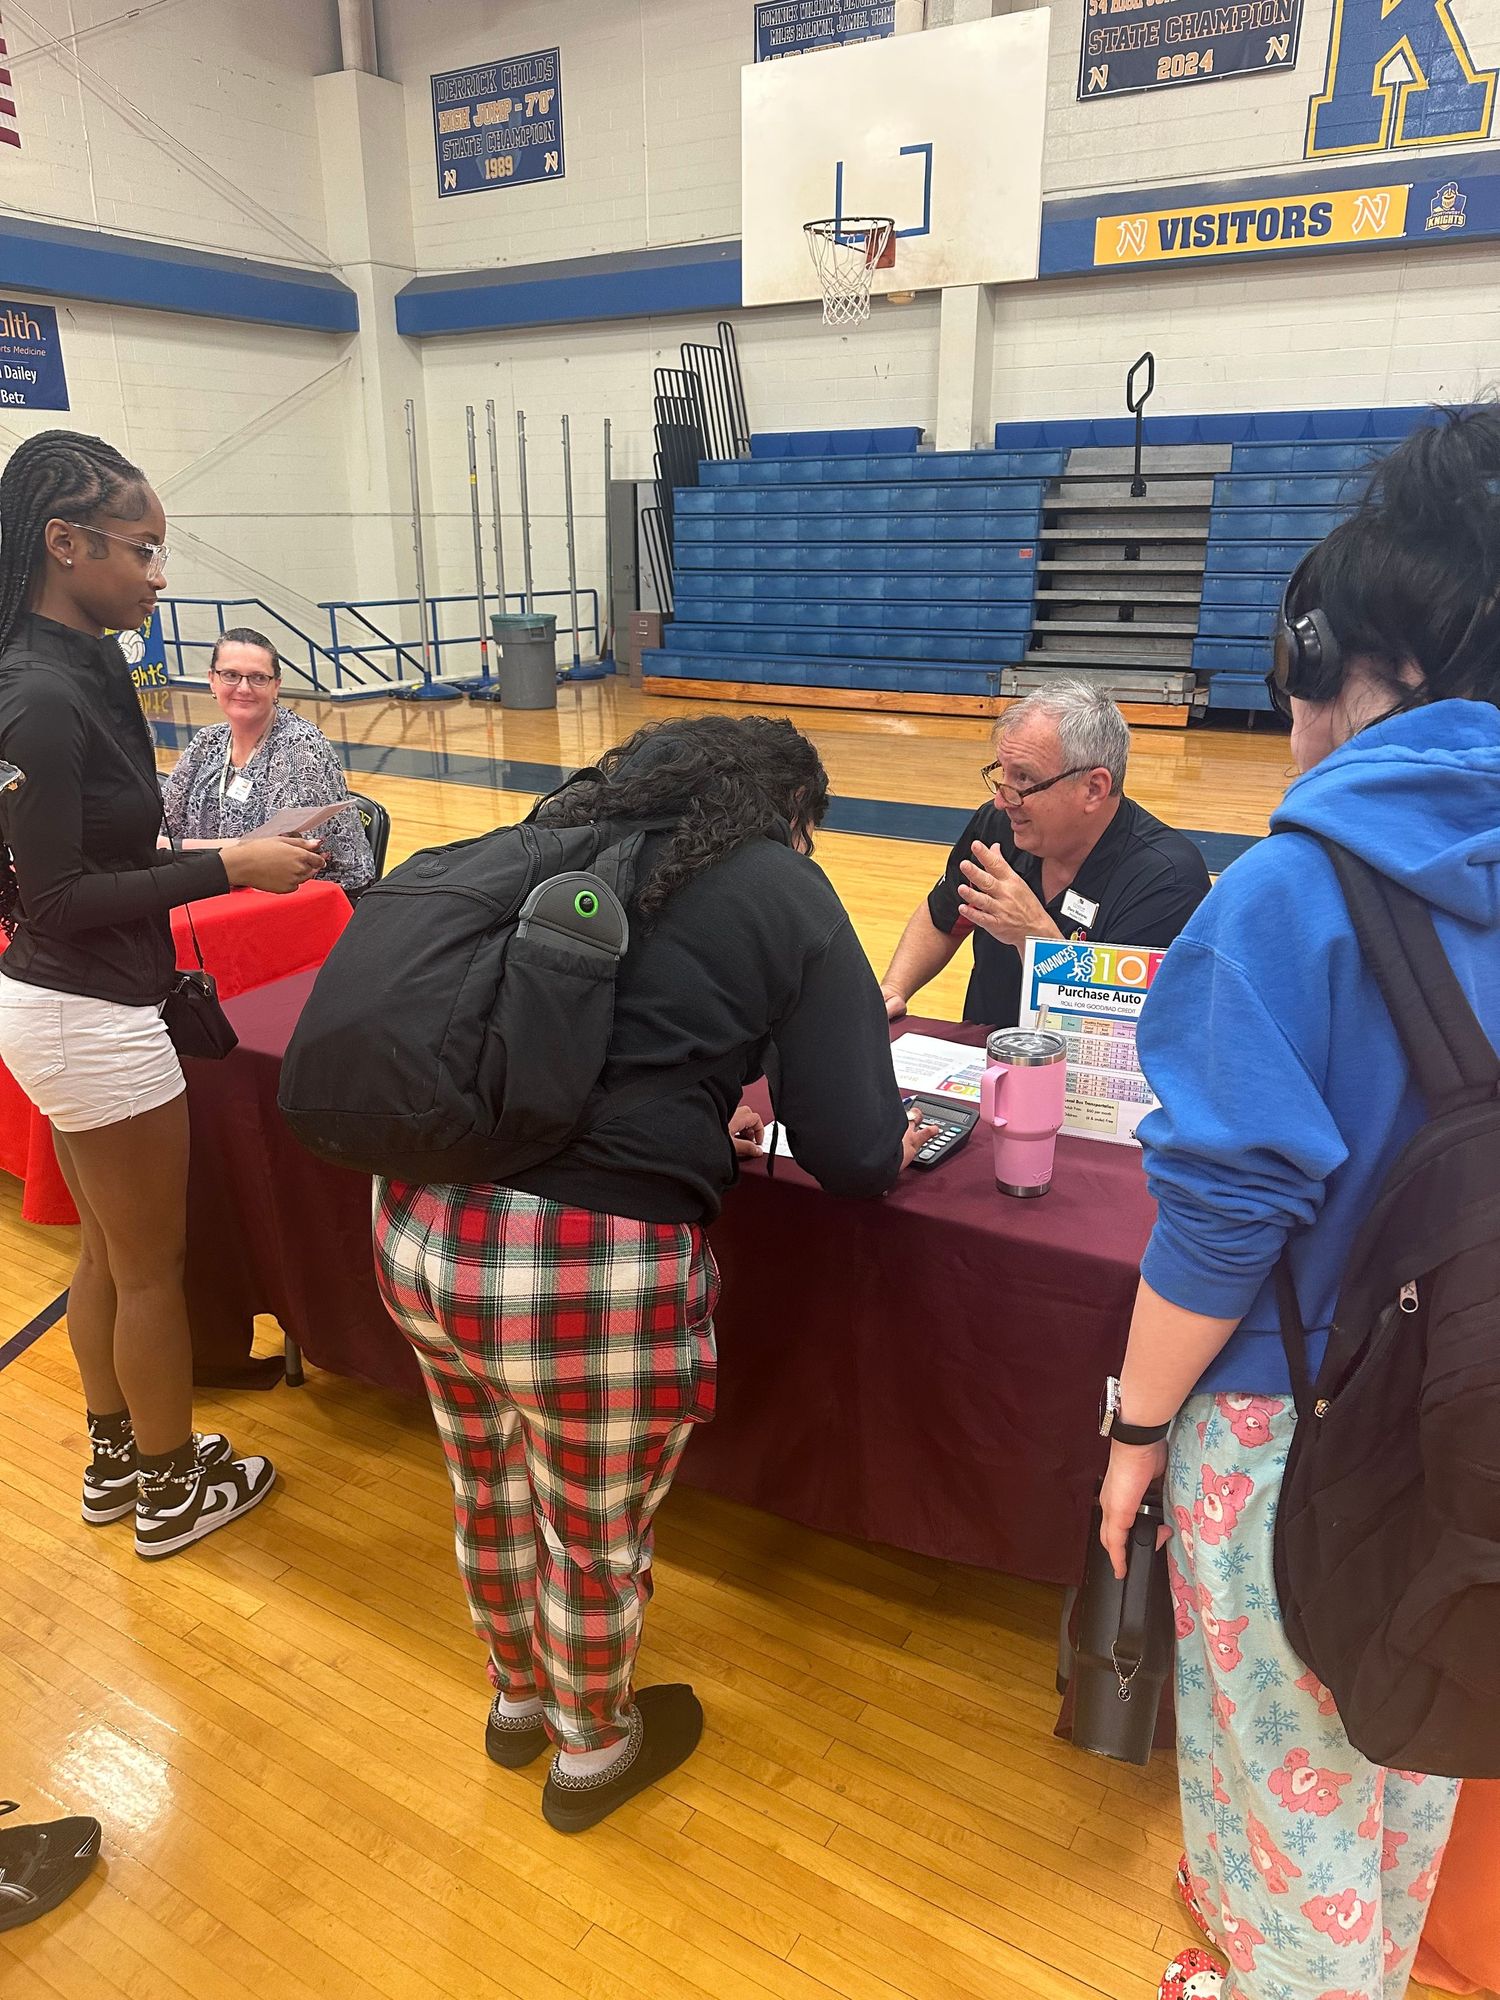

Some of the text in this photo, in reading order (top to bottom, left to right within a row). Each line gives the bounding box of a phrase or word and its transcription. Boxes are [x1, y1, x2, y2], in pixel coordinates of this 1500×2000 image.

[760, 5, 798, 28] DOMINICK
[1089, 0, 1294, 56] STATE CHAMPION
[770, 25, 795, 46] MILES
[1157, 49, 1214, 80] 2024
[437, 56, 555, 103] DERRICK CHILDS
[438, 106, 471, 134] HIGH
[473, 98, 512, 127] JUMP
[443, 120, 555, 161] STATE CHAMPION
[485, 155, 514, 179] 1989
[1157, 202, 1333, 251] VISITORS
[1428, 215, 1464, 228] KNIGHTS
[0, 345, 46, 356] rts Medicine
[4, 365, 37, 384] Dailey
[1, 389, 26, 405] Betz
[131, 662, 167, 688] ghts
[1034, 945, 1078, 978] FINANCES
[1058, 985, 1141, 1004] Purchase Auto
[1117, 1006, 1136, 1014] CREDIT
